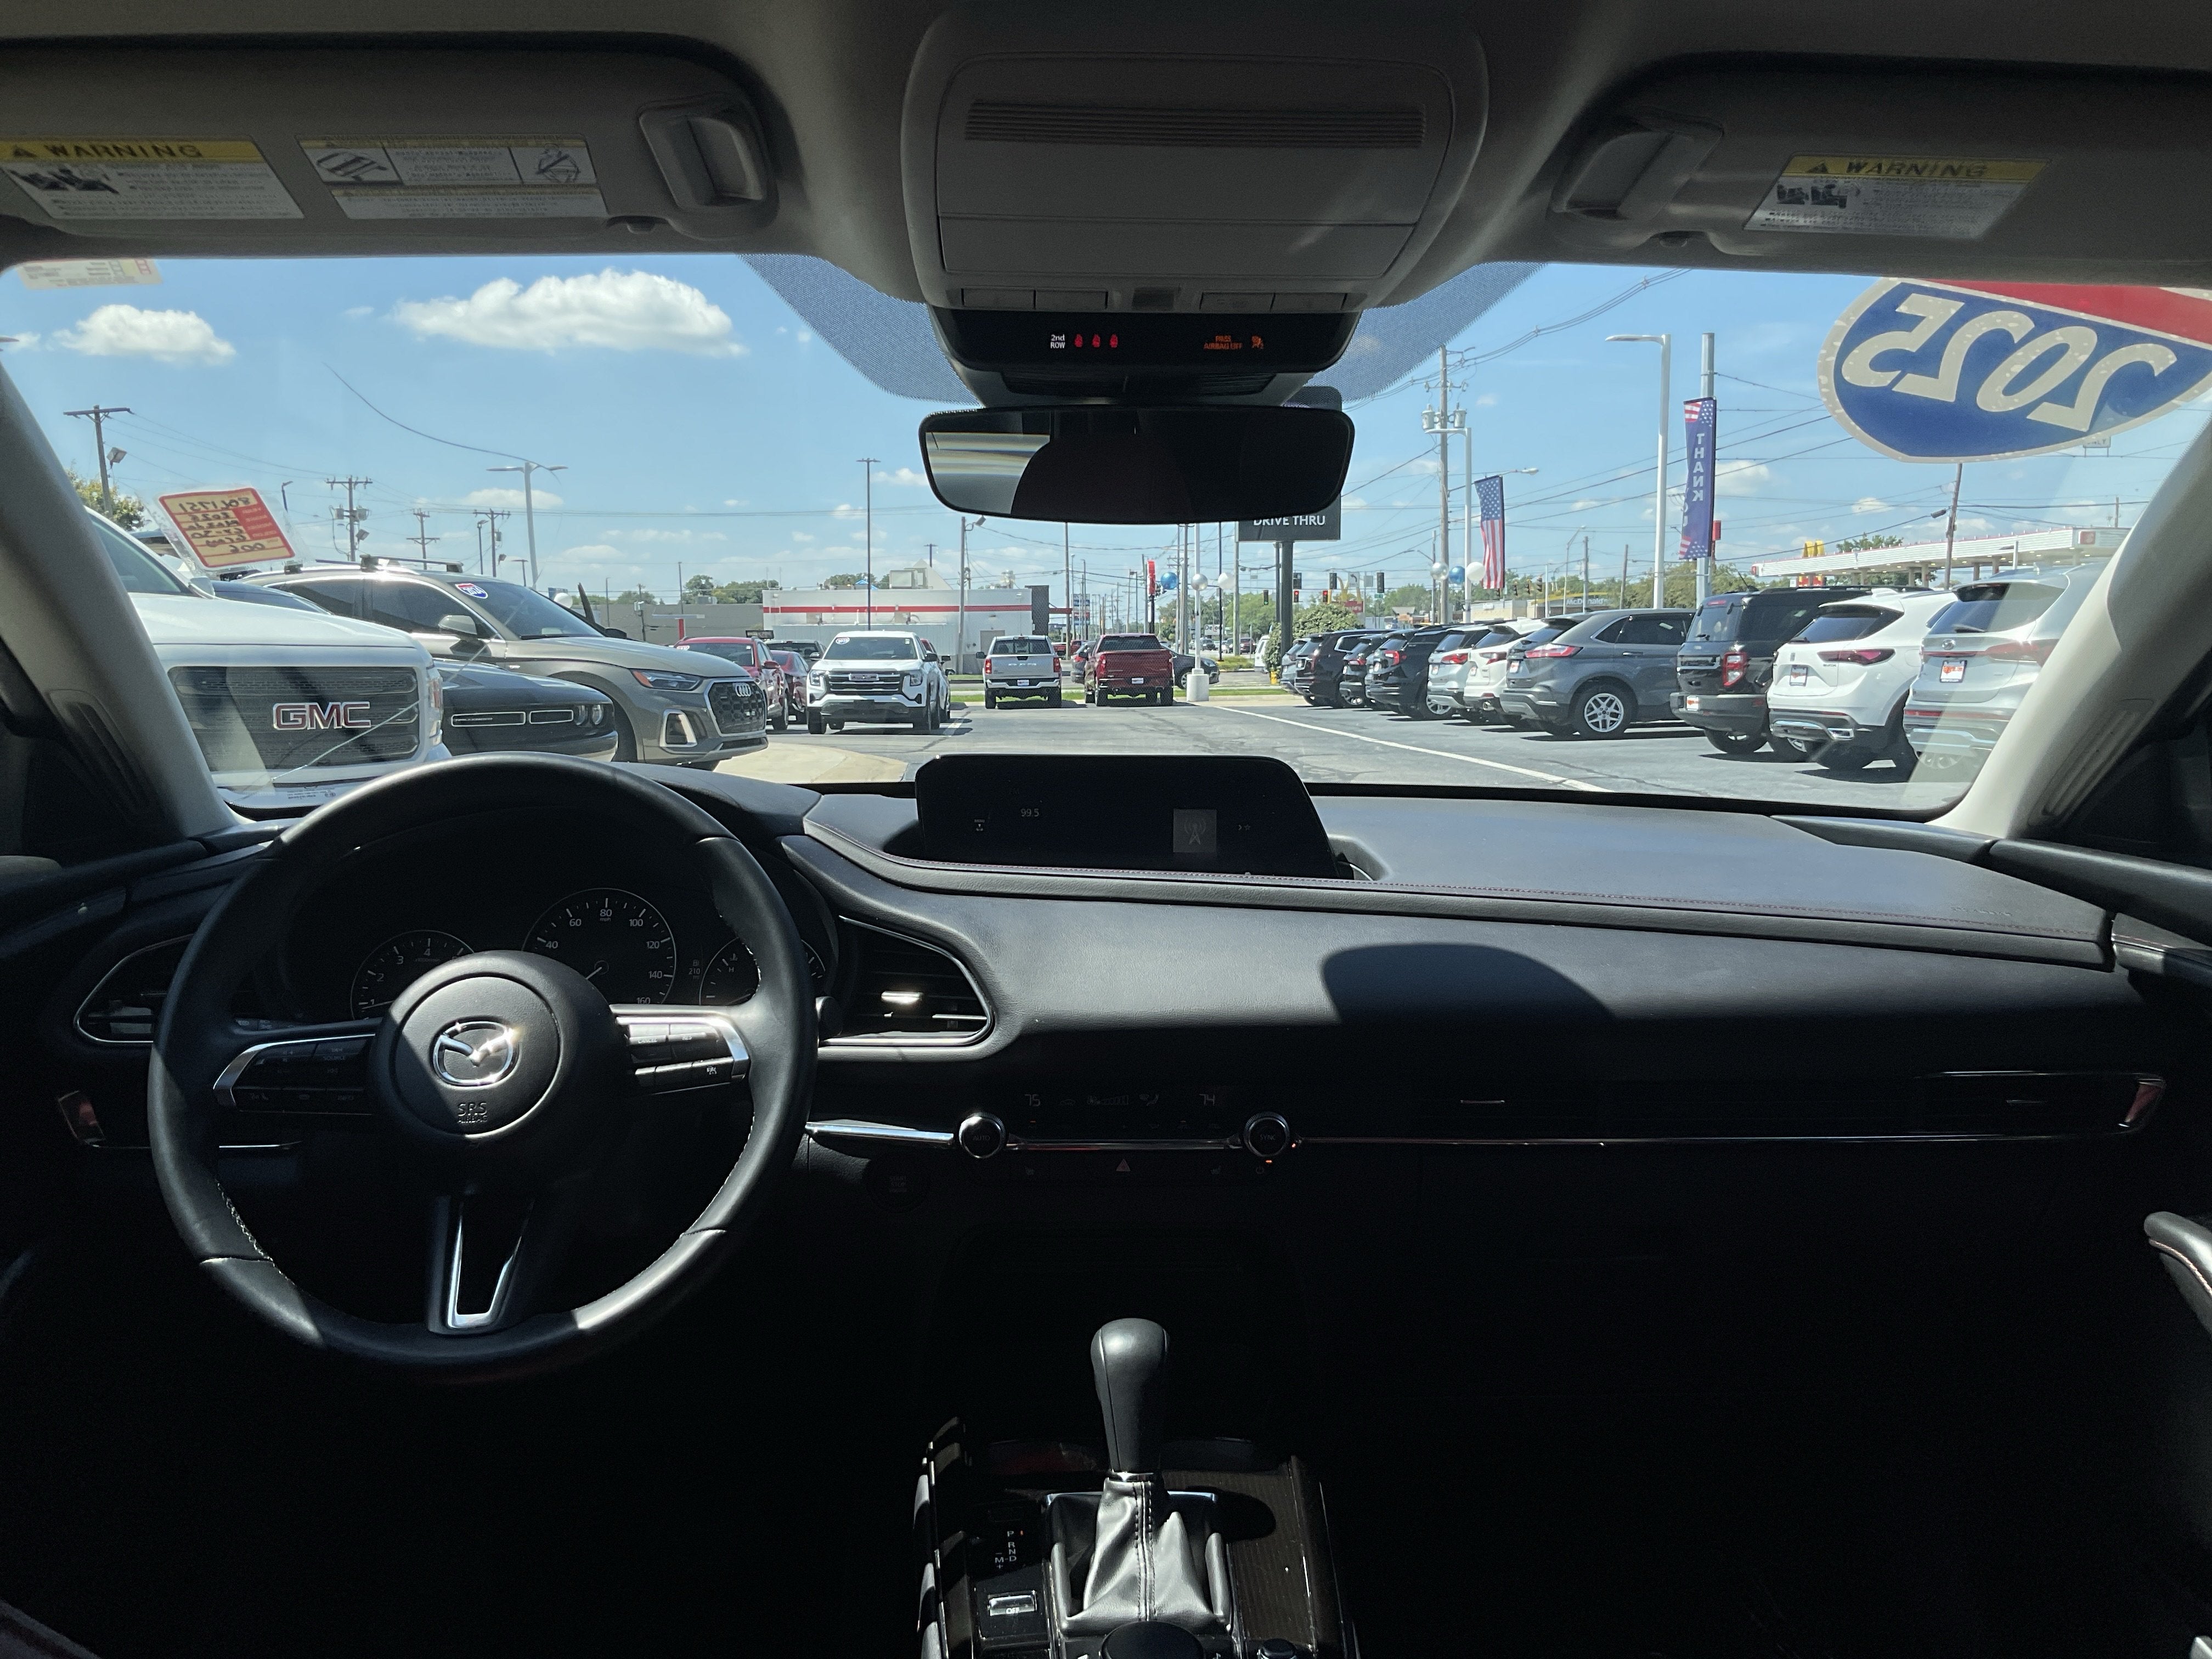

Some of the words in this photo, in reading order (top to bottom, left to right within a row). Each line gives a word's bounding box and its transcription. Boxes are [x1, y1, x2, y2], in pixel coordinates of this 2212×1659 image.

[43, 144, 203, 157] WARNING
[1847, 162, 1988, 177] WARNING
[1293, 516, 1325, 526] THRU
[273, 701, 371, 730] GMC
[545, 941, 558, 949] 40
[647, 941, 659, 949] 120
[423, 948, 431, 956] 4
[397, 956, 404, 964] 3
[377, 973, 384, 982] 2
[1025, 1094, 1041, 1107] 75
[458, 1102, 487, 1116] SRS
